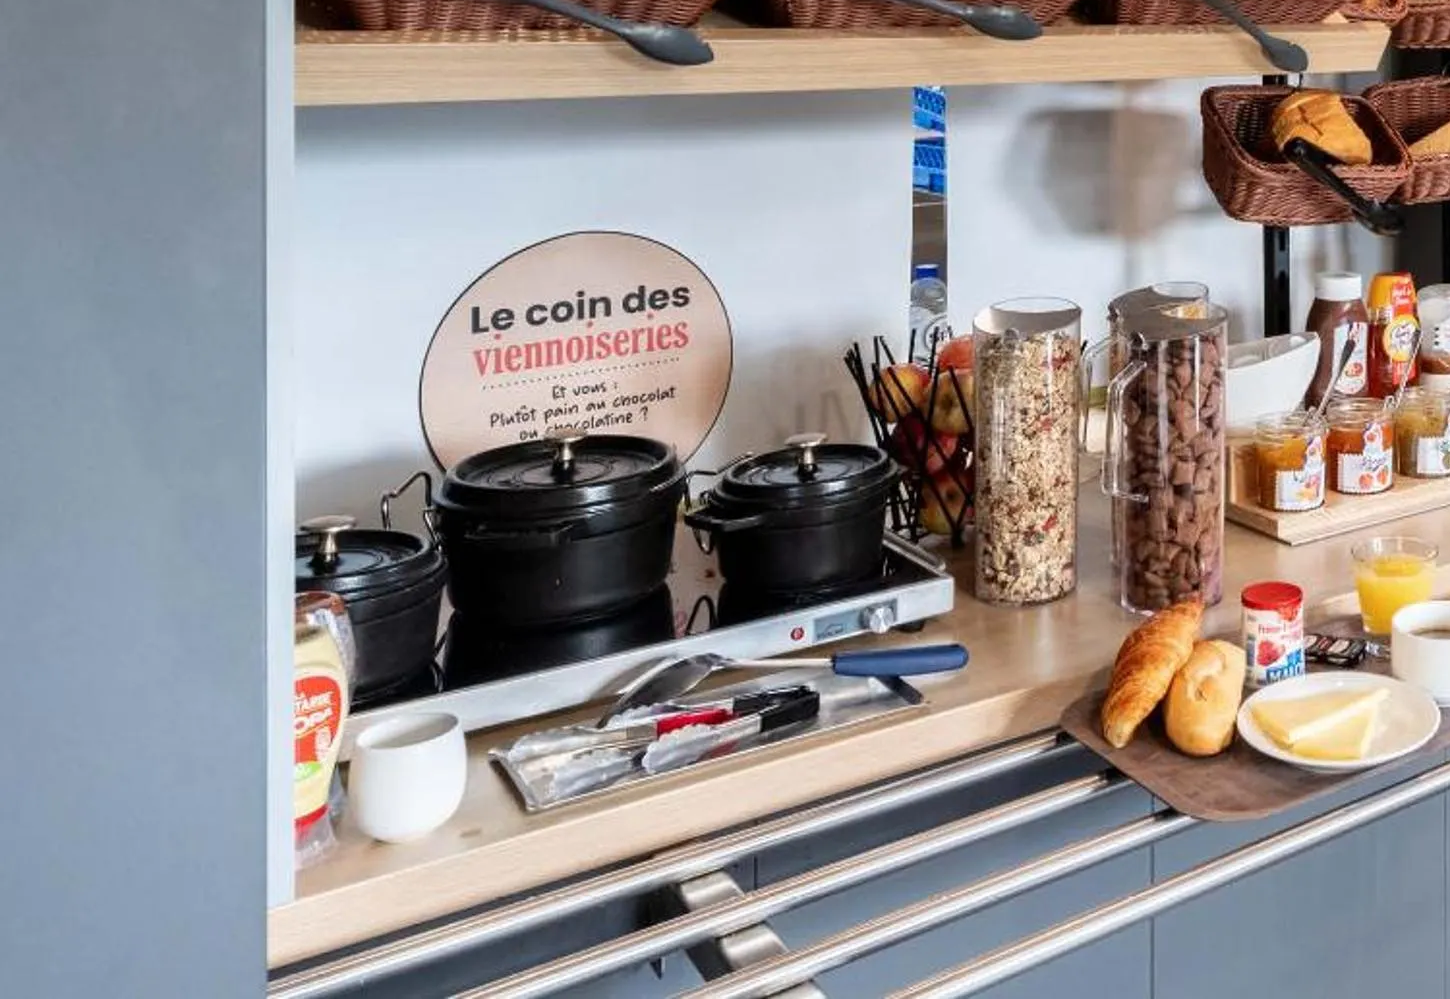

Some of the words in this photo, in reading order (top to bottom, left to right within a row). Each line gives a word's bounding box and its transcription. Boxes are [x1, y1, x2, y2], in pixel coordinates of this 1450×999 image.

[470, 305, 515, 335] Le
[525, 290, 612, 327] coin
[622, 285, 691, 316] des
[473, 313, 690, 378] viennoiseries
[489, 405, 537, 429] Plutôt
[544, 402, 579, 425] pain
[585, 400, 607, 414] au
[612, 387, 676, 409] chocolat
[551, 384, 566, 400] Et
[572, 382, 607, 396] vous
[519, 429, 539, 442] ou
[639, 407, 649, 421] ?
